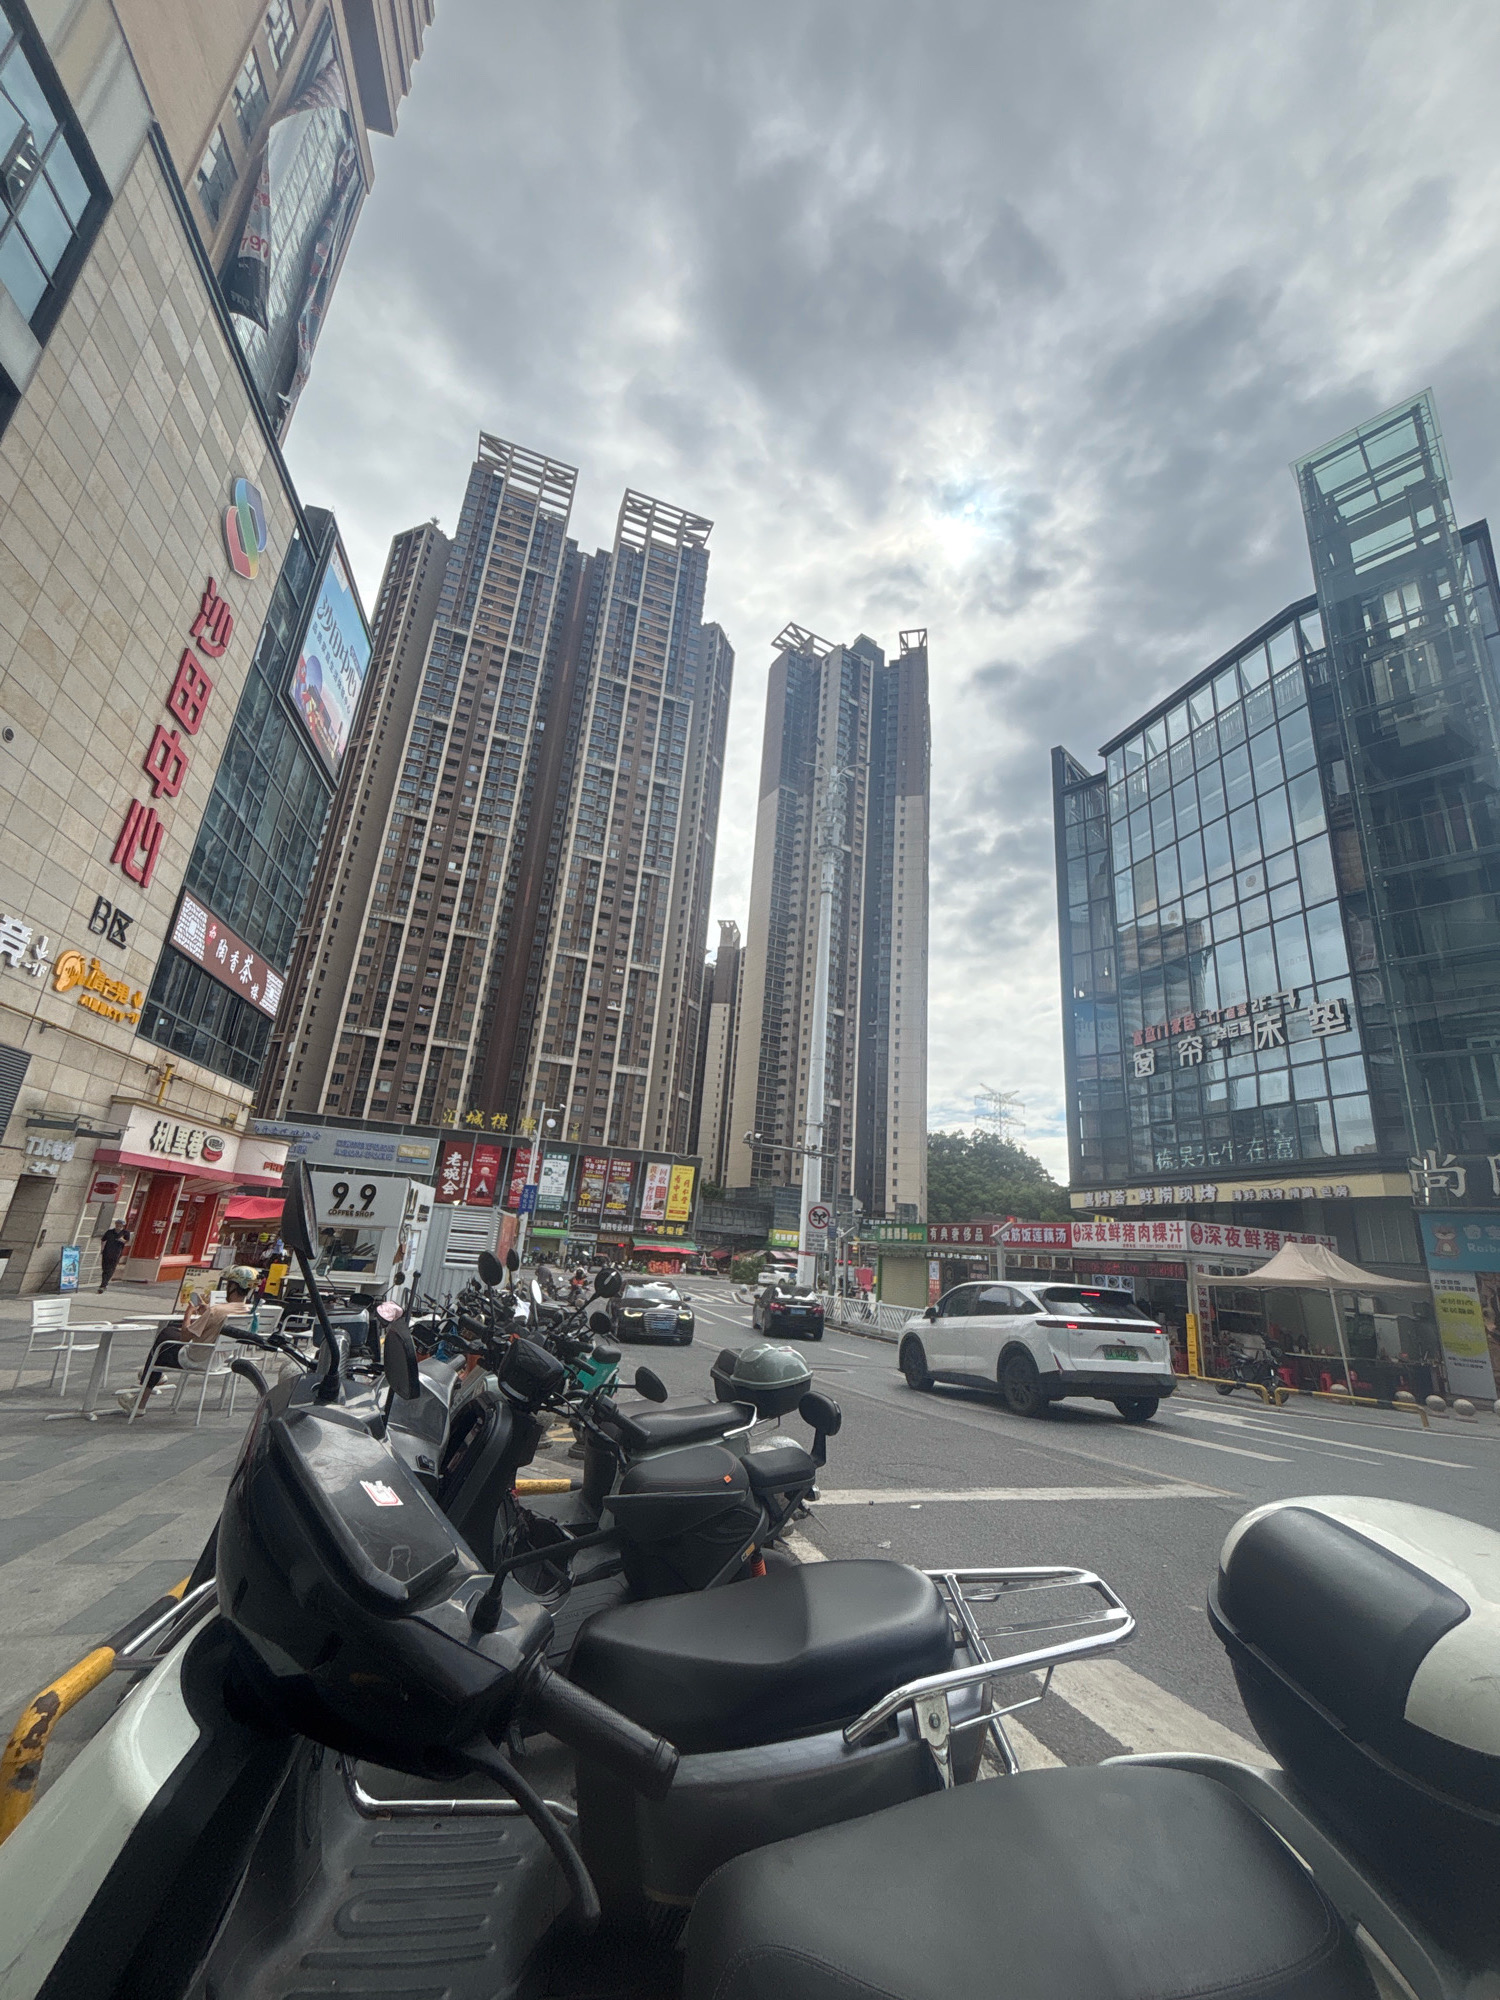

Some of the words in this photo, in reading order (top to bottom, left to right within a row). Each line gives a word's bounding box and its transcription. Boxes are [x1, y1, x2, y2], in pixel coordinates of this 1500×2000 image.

[315, 595, 358, 698] 沙田中心
[111, 576, 234, 889] 沙田中心
[88, 895, 135, 950] B区
[442, 1108, 537, 1133] 汇城棋牌
[442, 1151, 463, 1195] 老碗会
[332, 1181, 377, 1211] 9.9
[328, 1208, 354, 1217] COFFEE
[355, 1209, 375, 1218] SHOP
[929, 1226, 984, 1243] 有典奢侈品
[1081, 1222, 1184, 1243] 深夜鲜猪肉粿汁
